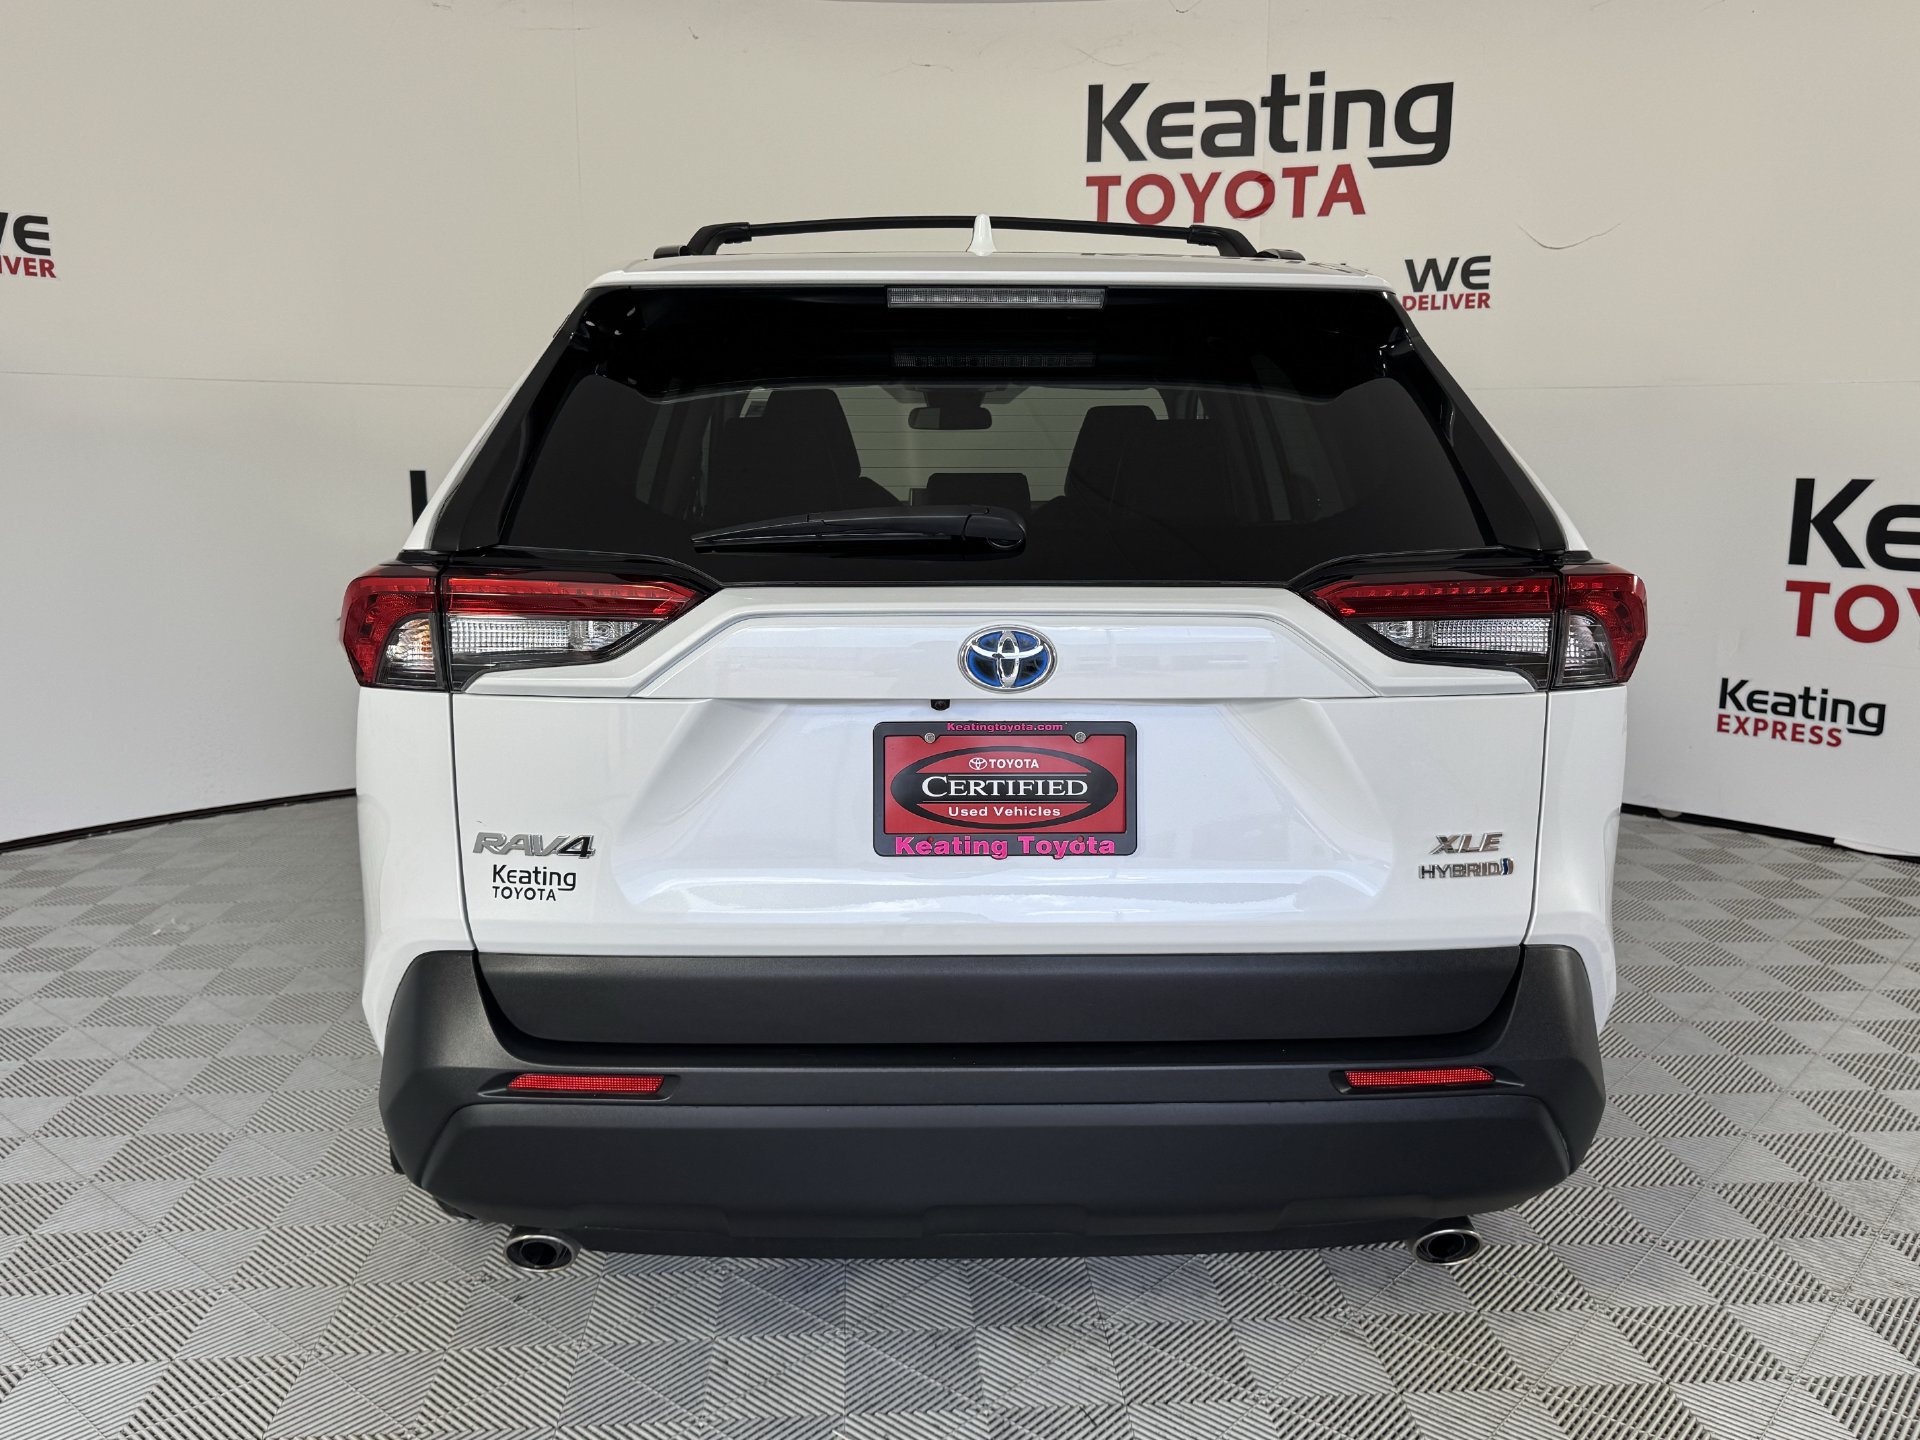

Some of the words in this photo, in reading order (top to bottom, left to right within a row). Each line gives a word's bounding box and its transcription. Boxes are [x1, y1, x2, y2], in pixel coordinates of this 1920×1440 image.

[1087, 70, 1454, 168] Keating
[1086, 164, 1366, 225] TOYOTA
[0, 212, 51, 256] E
[1405, 255, 1491, 292] WE
[1402, 292, 1491, 311] DELIVER
[1785, 580, 1920, 643] TO
[1718, 677, 1886, 737] Keating
[946, 722, 1063, 733] Keatingtoyota.com
[1716, 713, 1842, 748] EXPRESS
[988, 758, 1039, 769] TOYOTA
[948, 807, 988, 817] Used
[993, 806, 1061, 817] Vehicles
[473, 832, 596, 860] RAV4
[895, 836, 1008, 860] Keating
[1018, 836, 1115, 860] Toyota
[1429, 832, 1503, 855] XLE
[492, 864, 576, 891] Keating
[1418, 862, 1500, 879] HYBRID
[492, 886, 557, 902] TOYOTA
